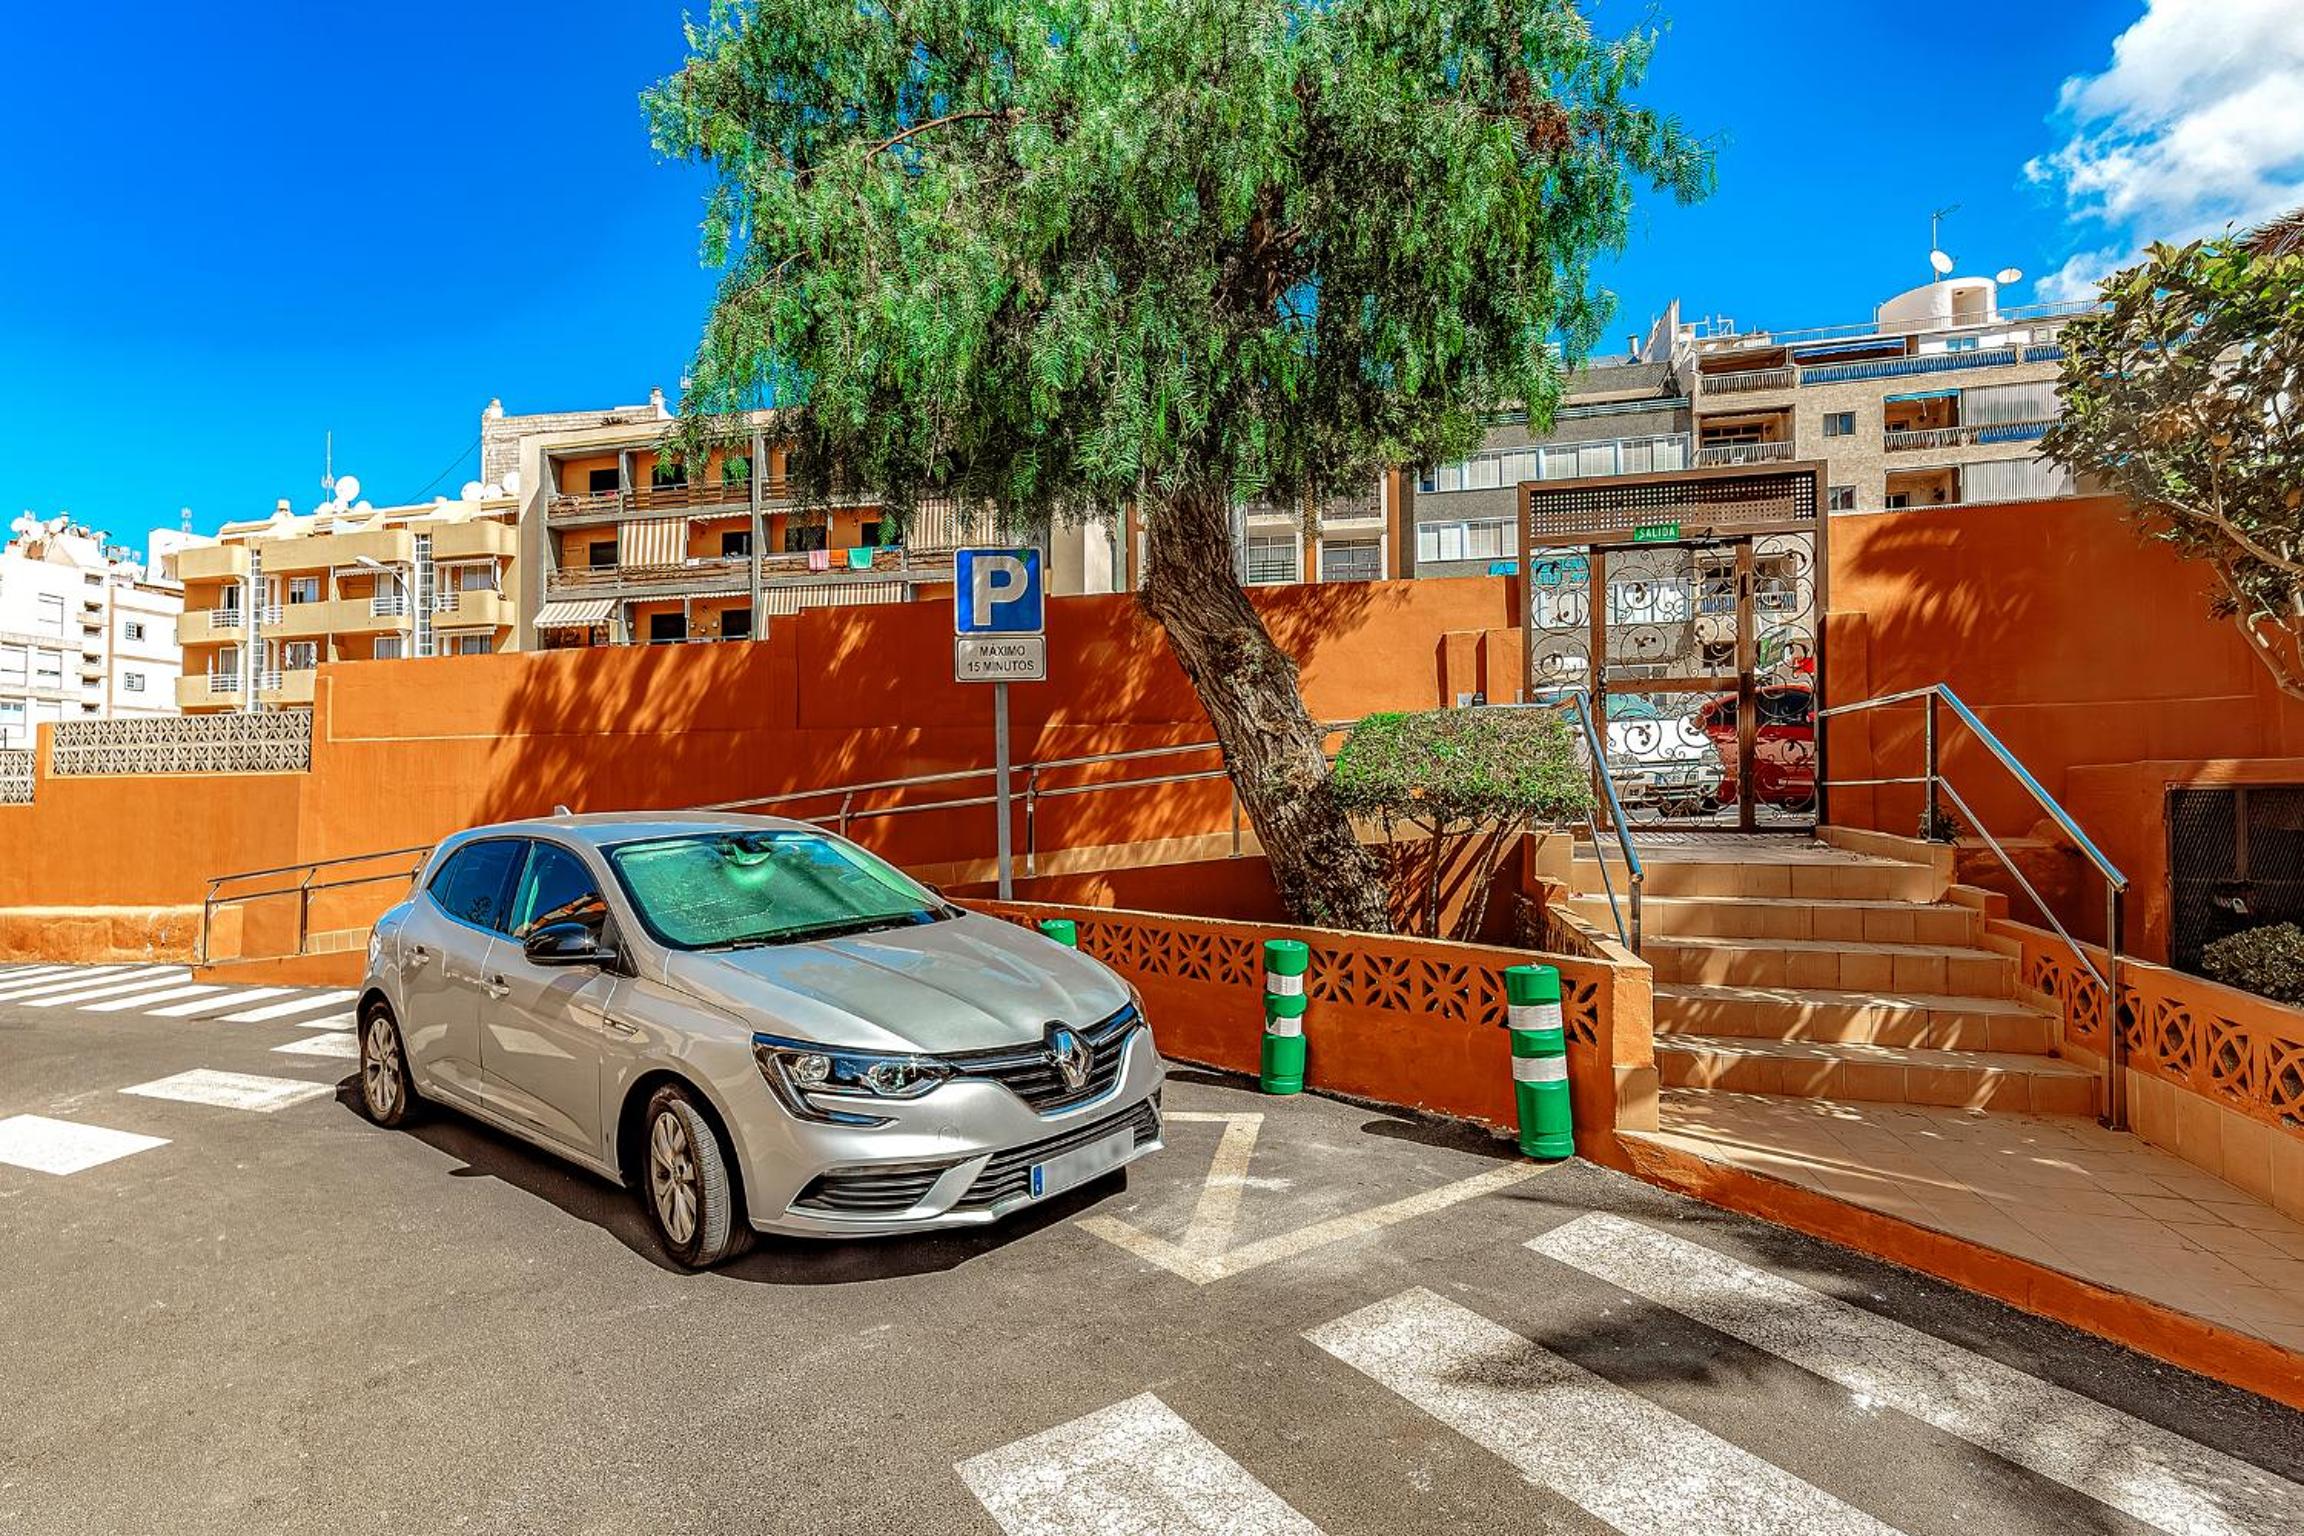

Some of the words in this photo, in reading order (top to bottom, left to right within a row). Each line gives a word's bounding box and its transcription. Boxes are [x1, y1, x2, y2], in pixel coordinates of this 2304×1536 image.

[1639, 526, 1675, 539] SALIDA
[972, 555, 1029, 626] P
[979, 643, 1026, 657] MÁXIMO
[967, 661, 980, 672] 15
[983, 660, 1035, 672] MINUTOS
